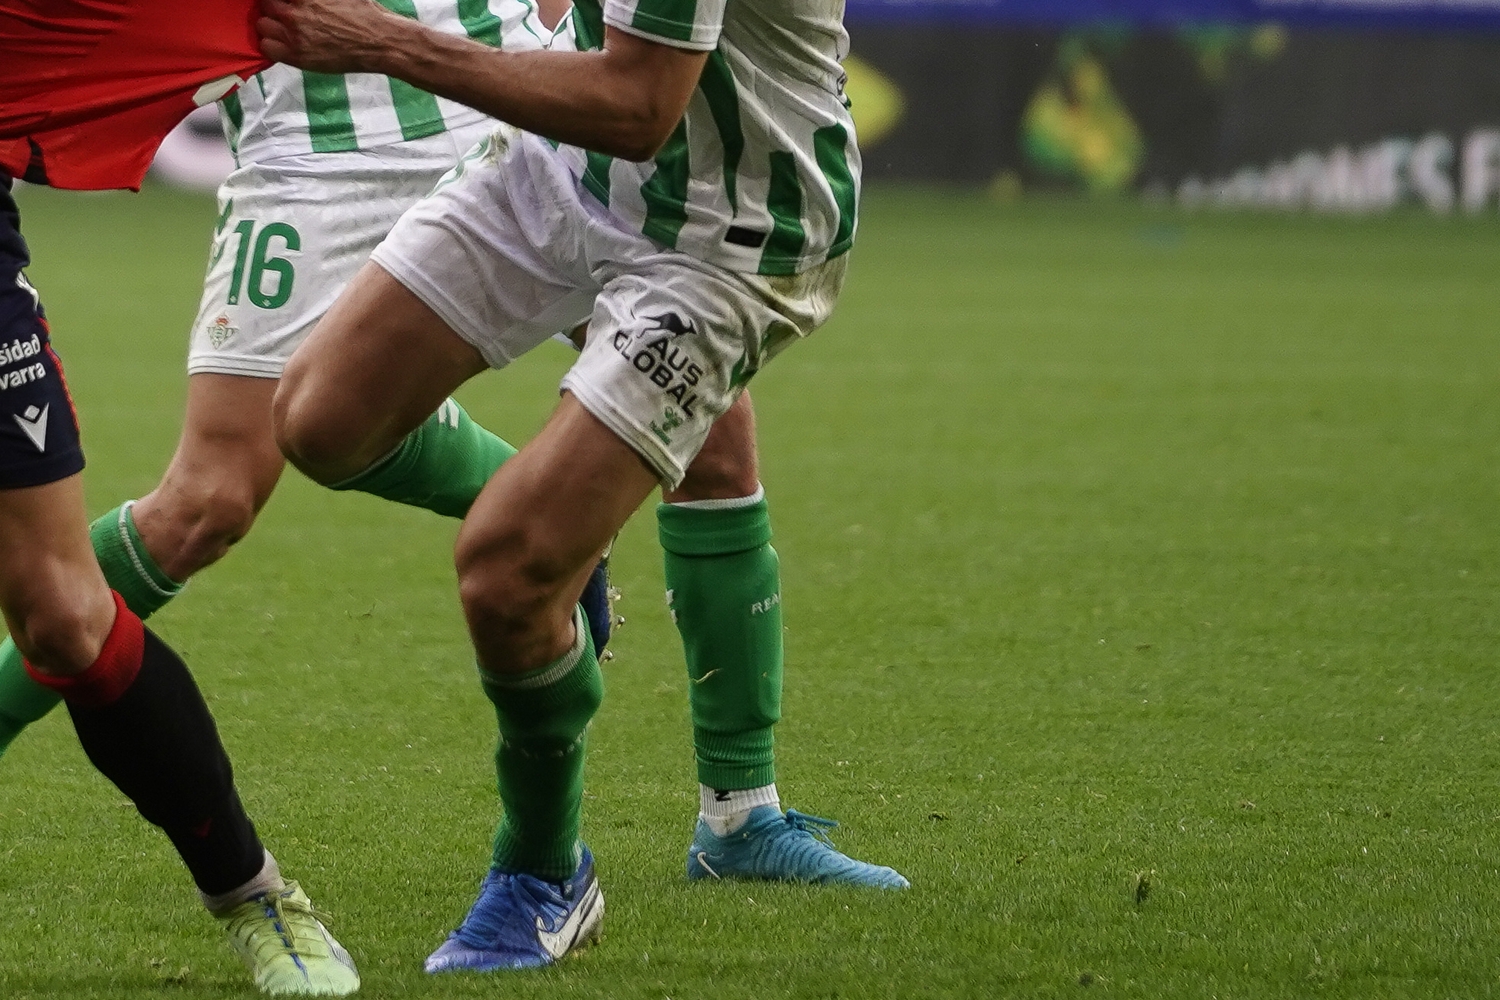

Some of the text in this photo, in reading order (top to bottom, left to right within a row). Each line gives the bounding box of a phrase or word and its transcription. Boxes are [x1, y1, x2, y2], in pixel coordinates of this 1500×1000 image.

[227, 219, 301, 310] 16
[613, 329, 698, 418] GLOBAL
[646, 336, 703, 387] AUS
